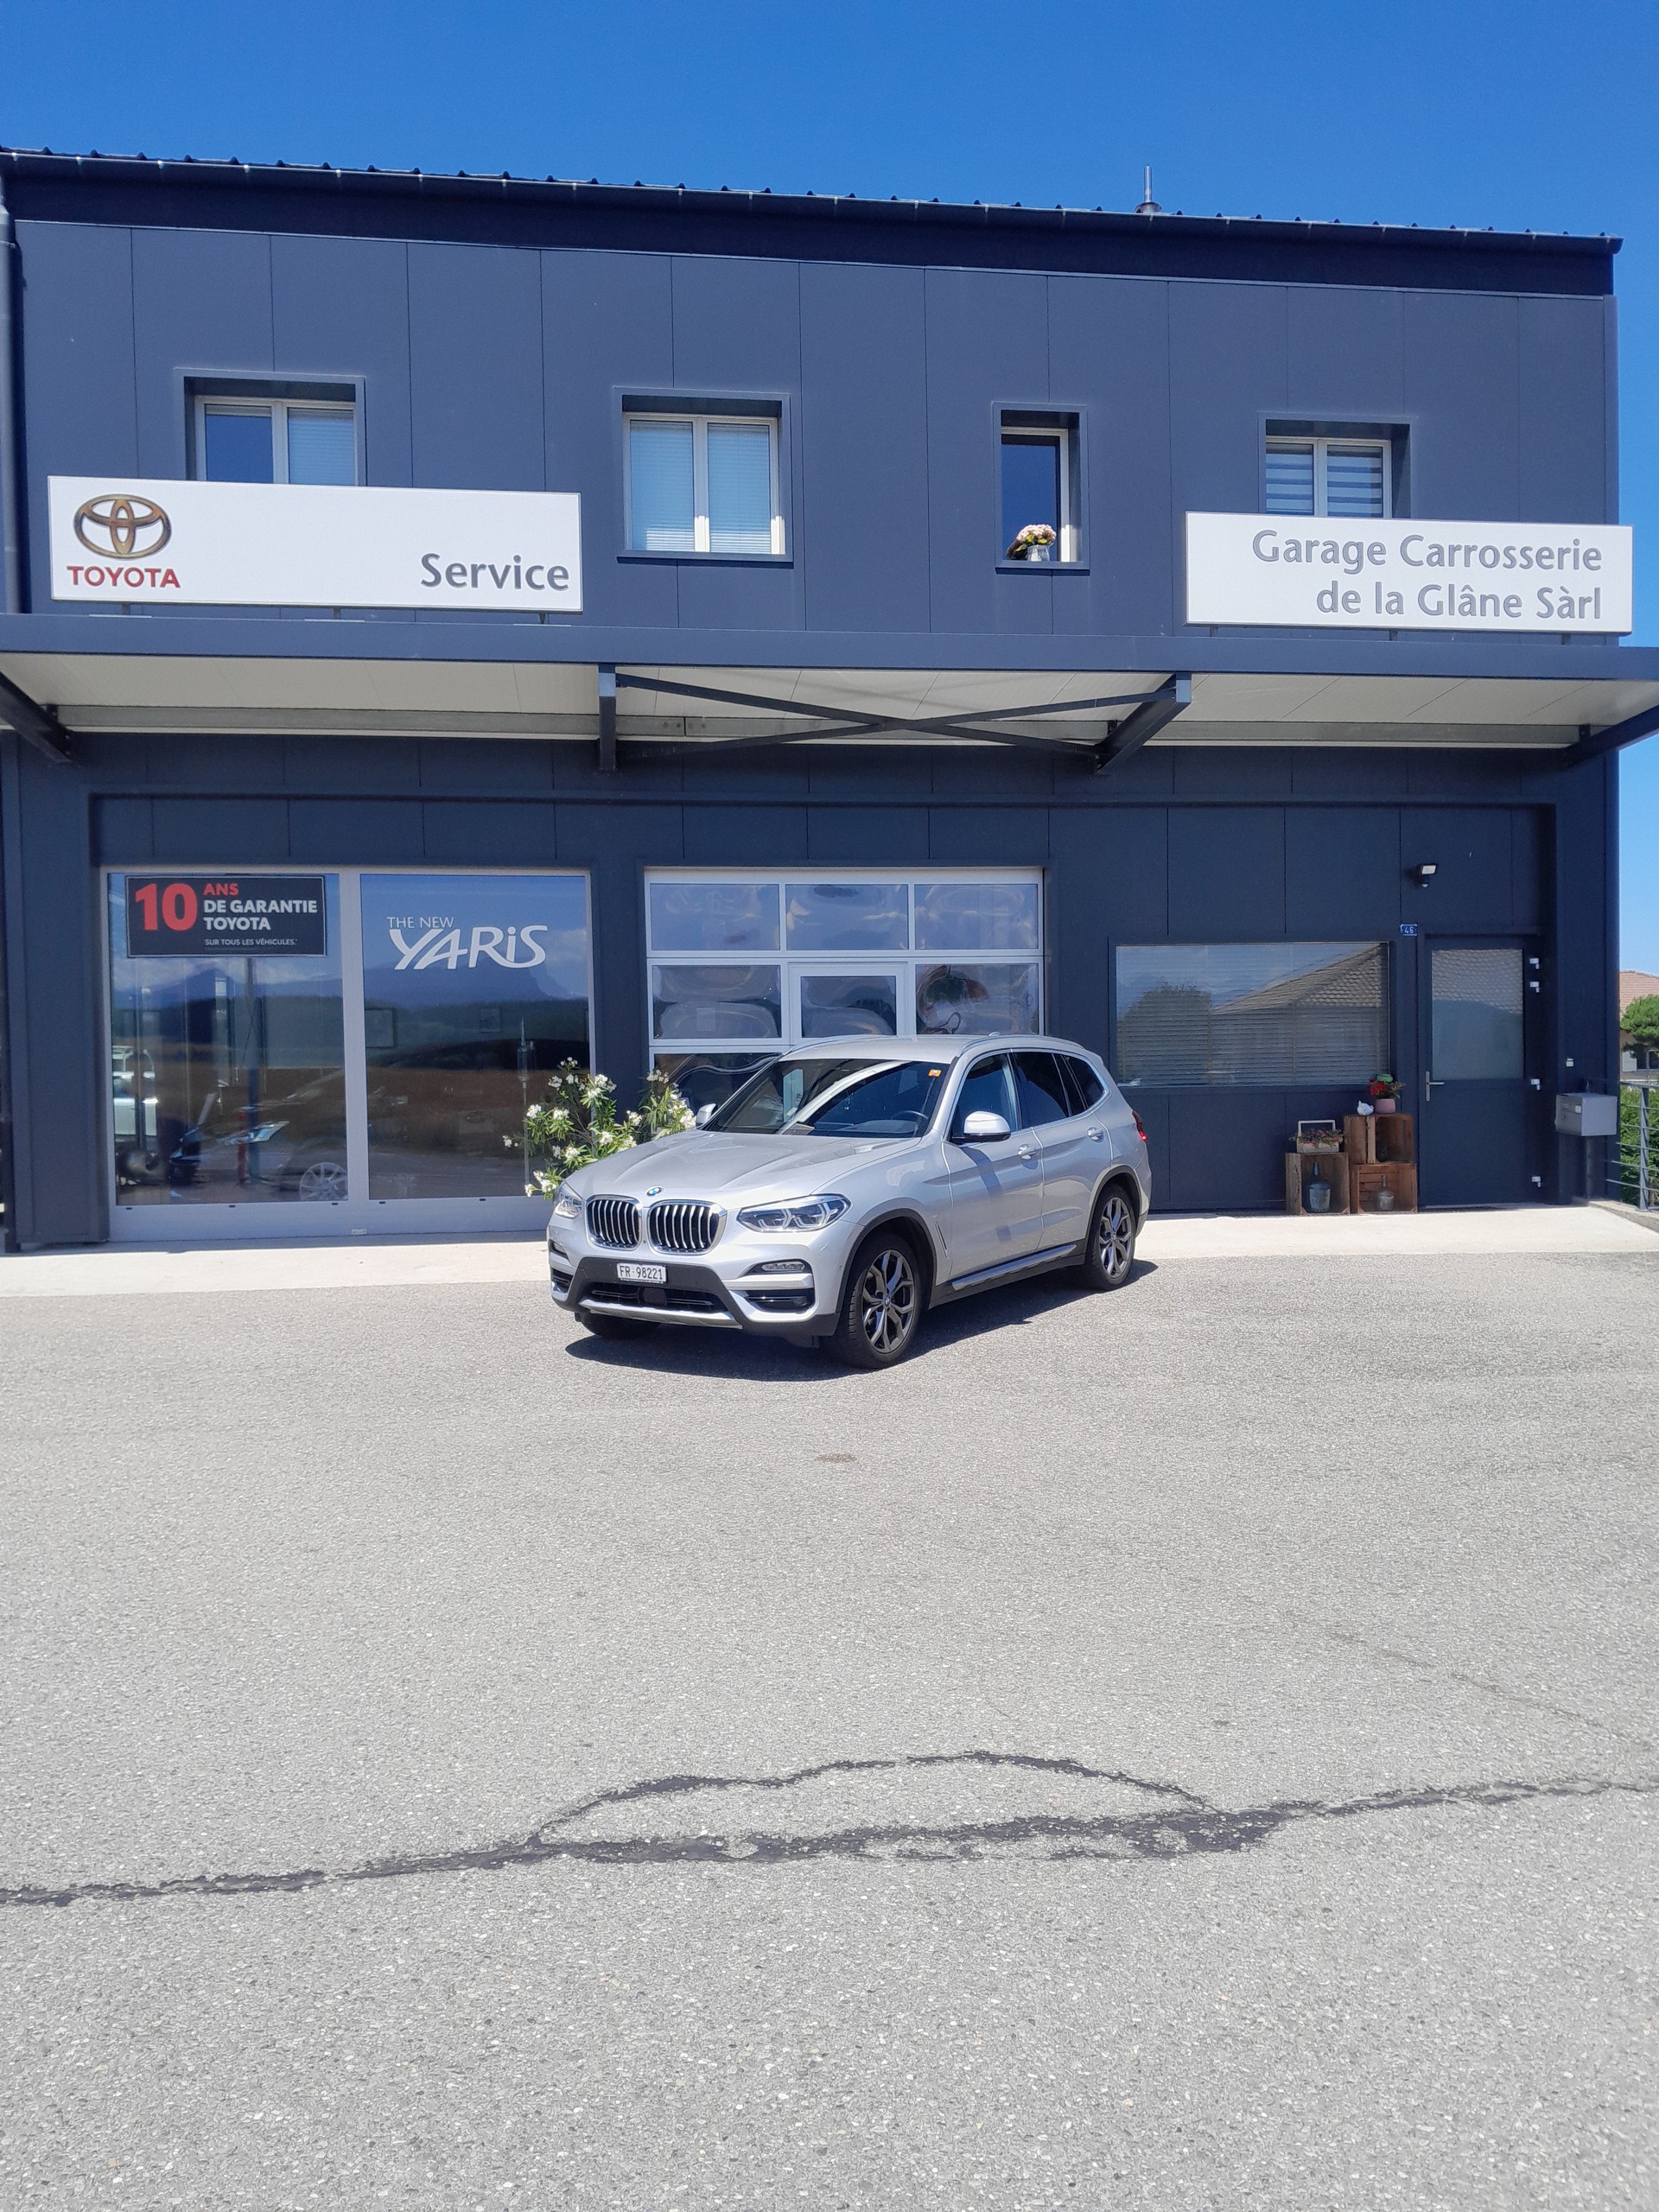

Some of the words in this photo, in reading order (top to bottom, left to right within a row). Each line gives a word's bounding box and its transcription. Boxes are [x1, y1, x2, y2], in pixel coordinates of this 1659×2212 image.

[1252, 530, 1387, 575] Garage
[1400, 535, 1602, 571] Carrosserie
[67, 566, 181, 589] TOYOTA
[420, 554, 569, 591] Service
[1316, 581, 1362, 613] de
[1376, 582, 1404, 615] la
[1418, 583, 1522, 619] Glâne
[1536, 586, 1600, 620] Sàrl
[203, 883, 238, 896] ANS
[135, 883, 198, 931] 10
[203, 899, 226, 913] DE
[230, 899, 318, 913] GARANTIE
[203, 917, 271, 931] TOYOTA
[387, 917, 415, 929] THE
[420, 916, 454, 929] NEW
